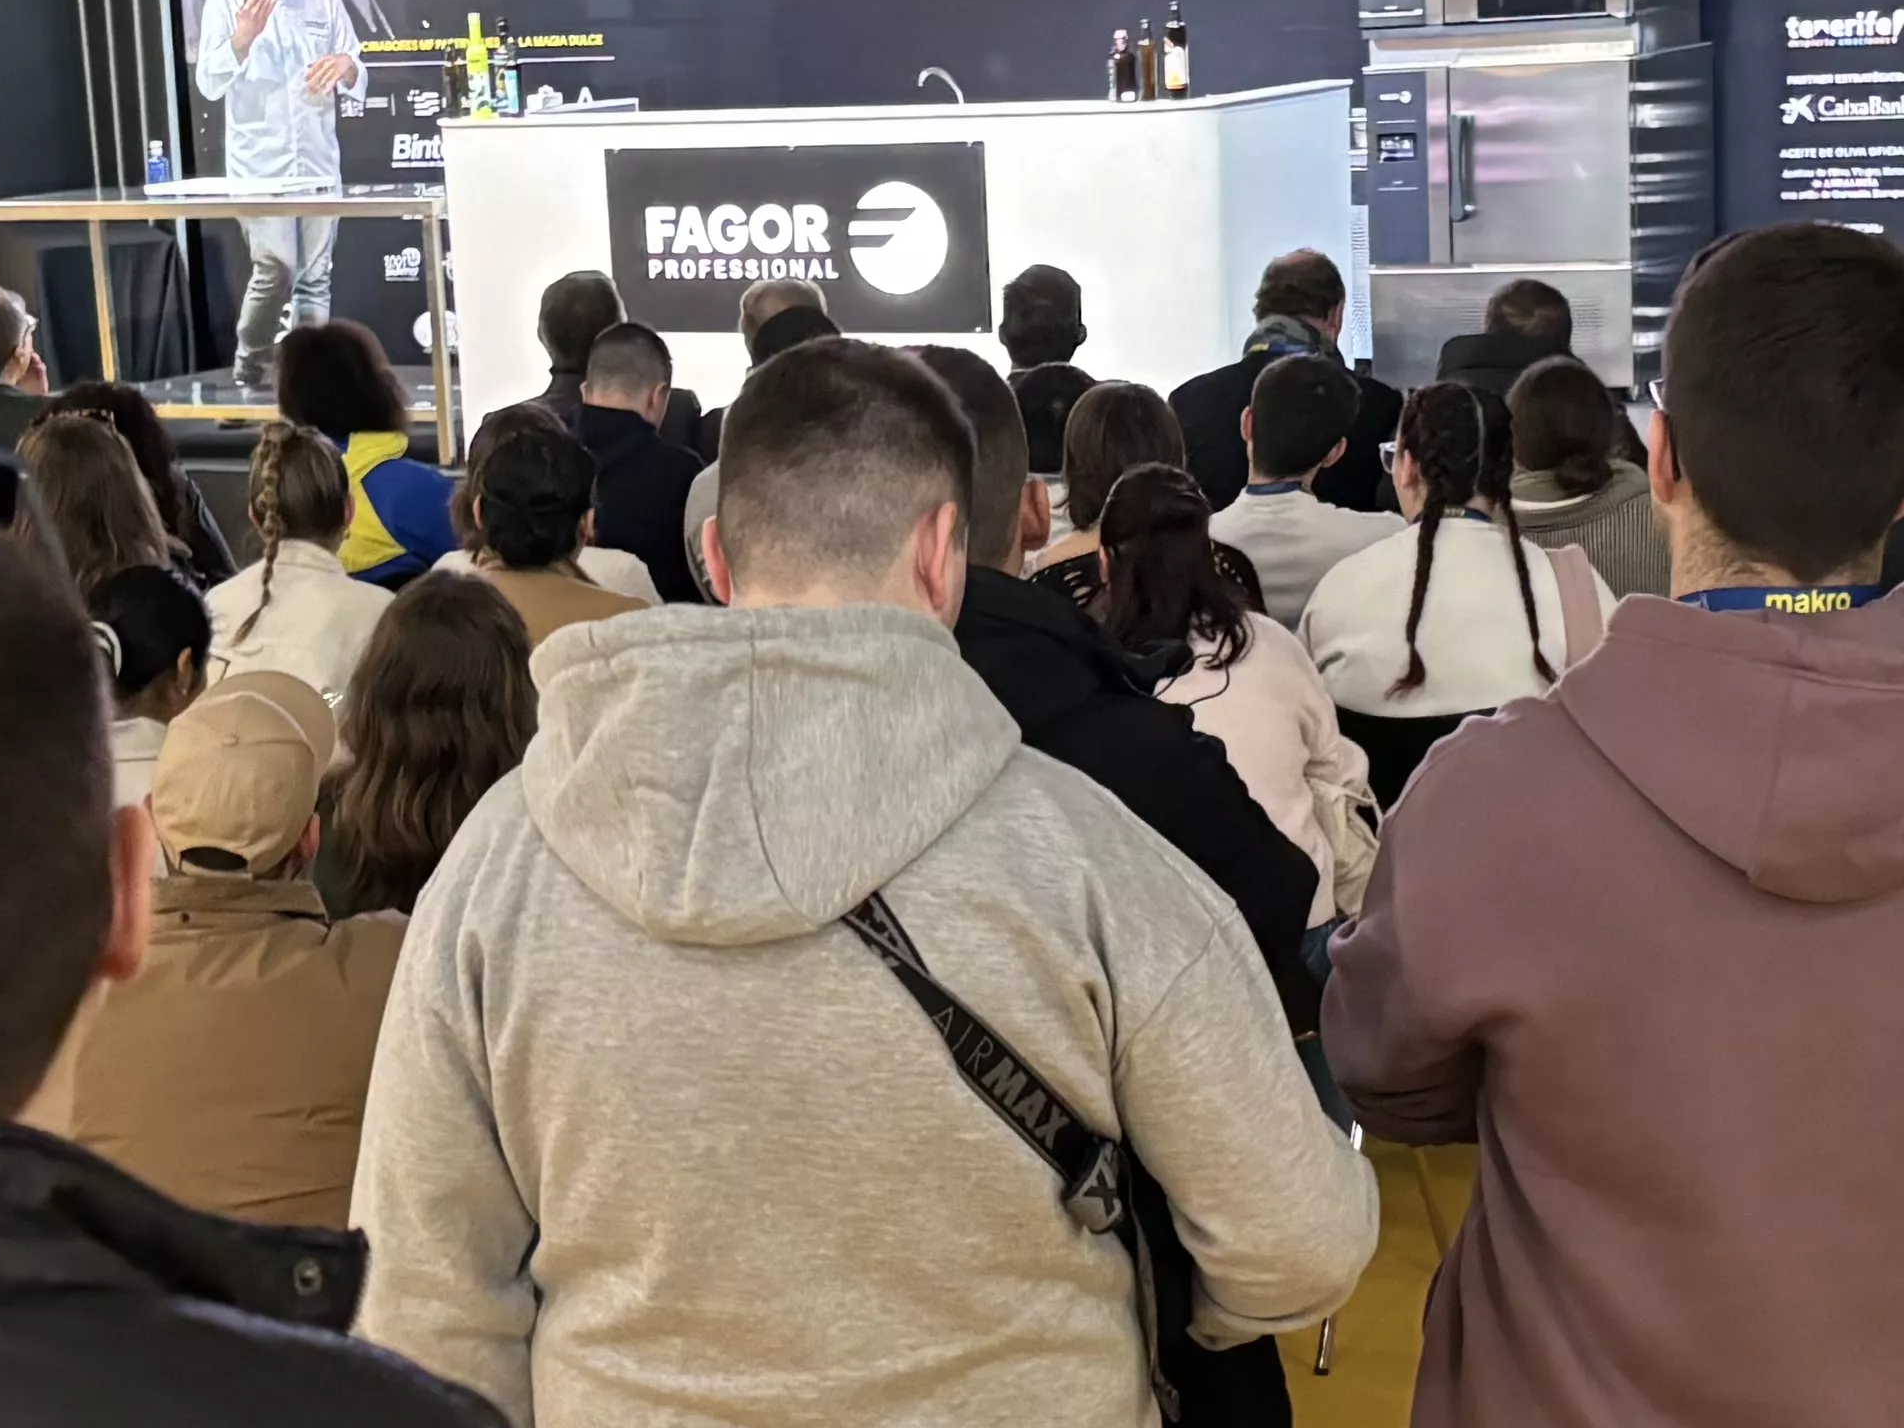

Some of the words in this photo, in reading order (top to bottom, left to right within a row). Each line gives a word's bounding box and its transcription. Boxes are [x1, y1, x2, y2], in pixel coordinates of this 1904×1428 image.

[1818, 147, 1834, 158] DE
[1835, 147, 1867, 158] OLIVA
[645, 203, 832, 254] FAGOR
[648, 258, 840, 280] PROFESSIONAL
[1765, 589, 1852, 614] makro
[982, 1057, 1072, 1152] MAX
